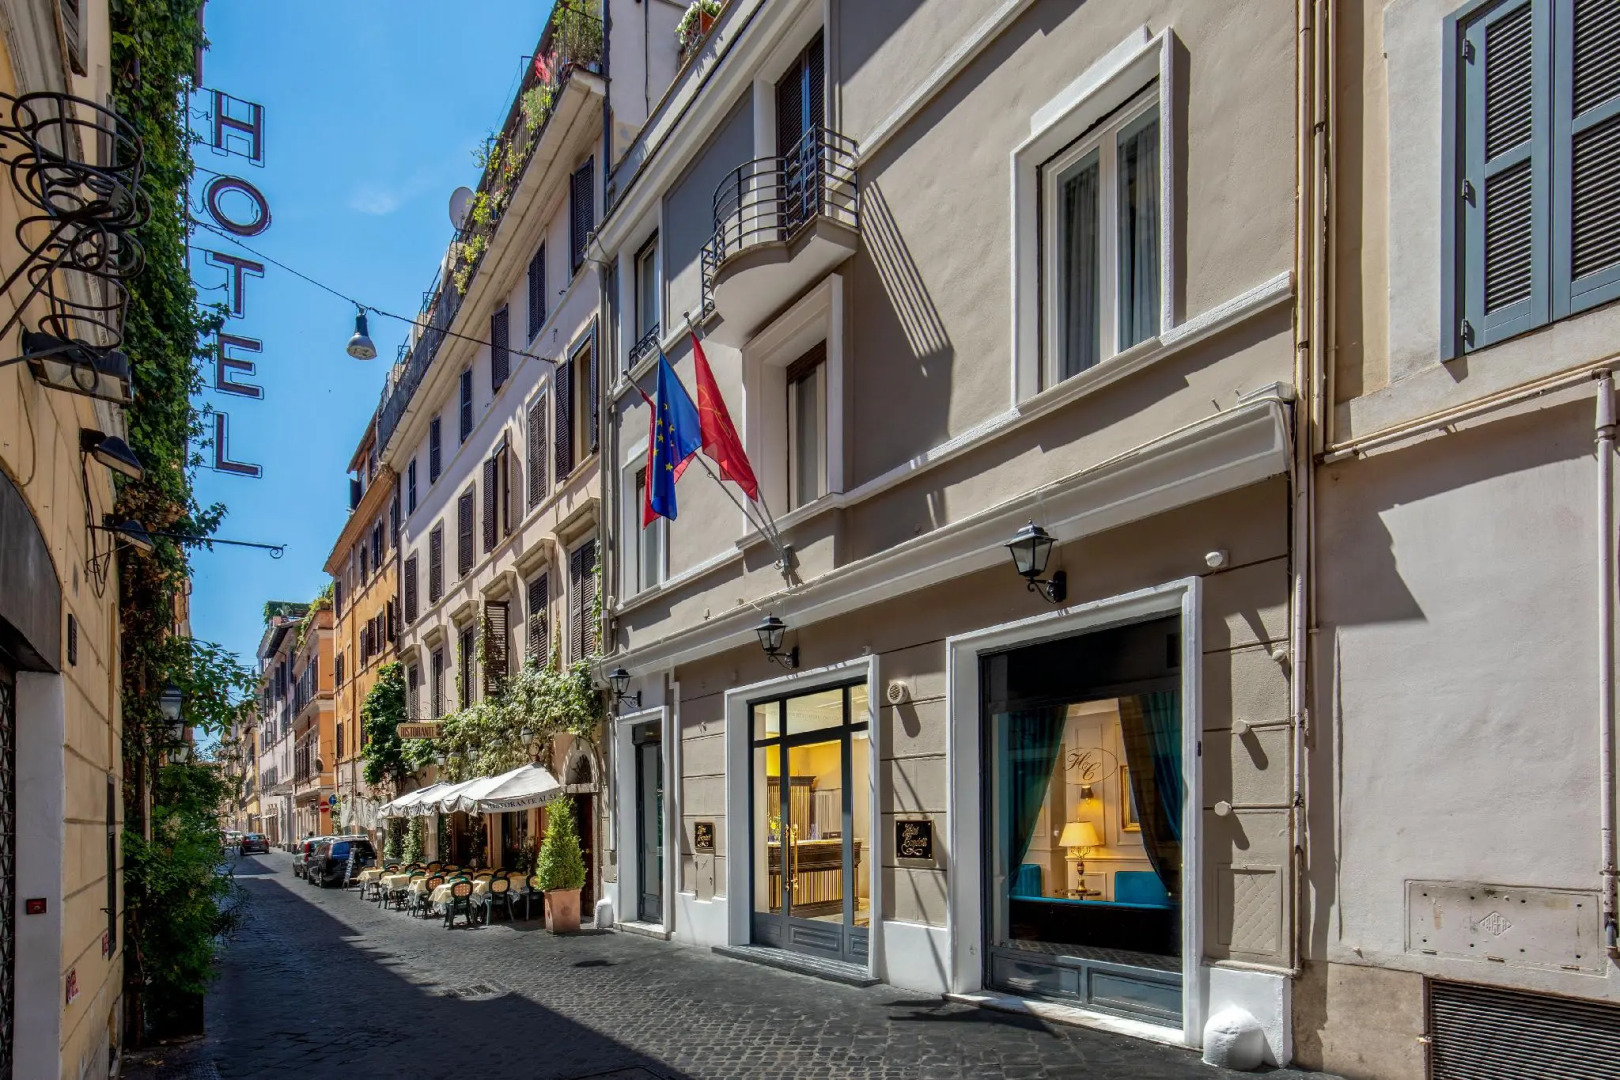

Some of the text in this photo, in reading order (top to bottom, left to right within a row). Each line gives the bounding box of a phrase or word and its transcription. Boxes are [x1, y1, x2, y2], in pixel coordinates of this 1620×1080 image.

[206, 90, 271, 478] HOTEL
[401, 727, 435, 738] RISTORANTE
[487, 798, 537, 809] RISTORANTE
